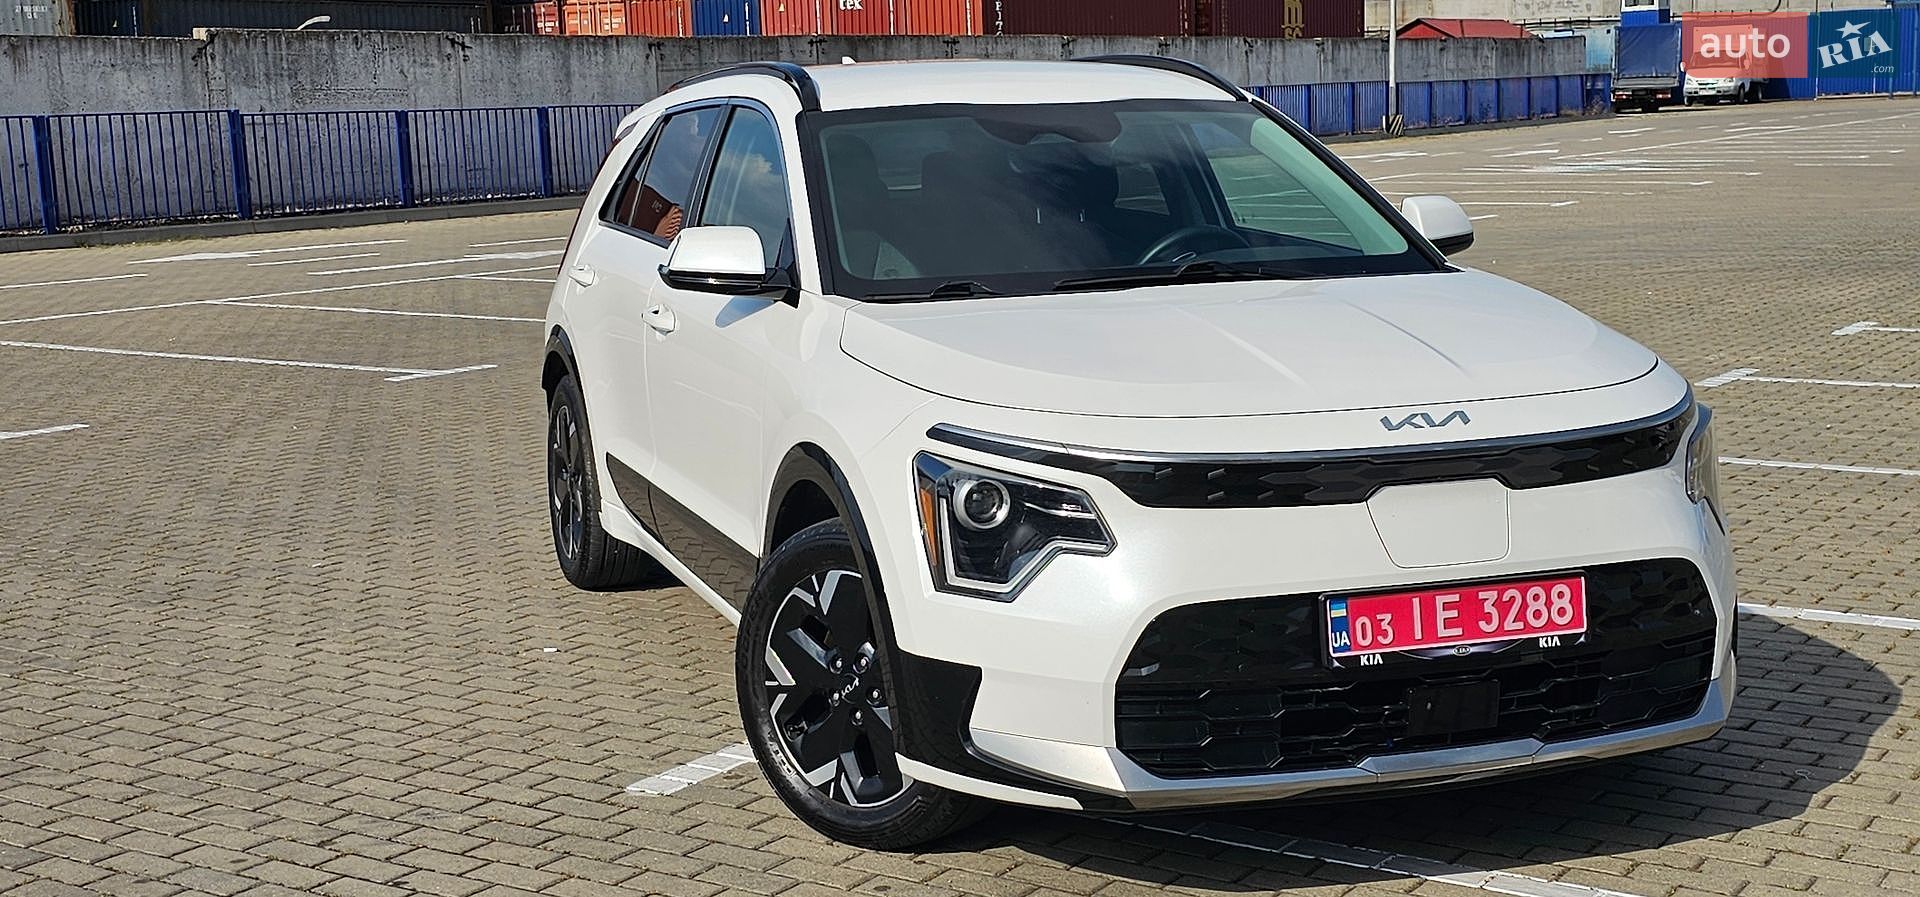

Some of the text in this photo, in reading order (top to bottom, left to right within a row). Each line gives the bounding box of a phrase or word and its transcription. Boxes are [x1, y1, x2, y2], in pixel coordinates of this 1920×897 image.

[1355, 584, 1574, 647] 03 IE 3288
[1332, 630, 1350, 648] UA
[1539, 635, 1561, 648] KIA
[1360, 653, 1383, 667] KIA
